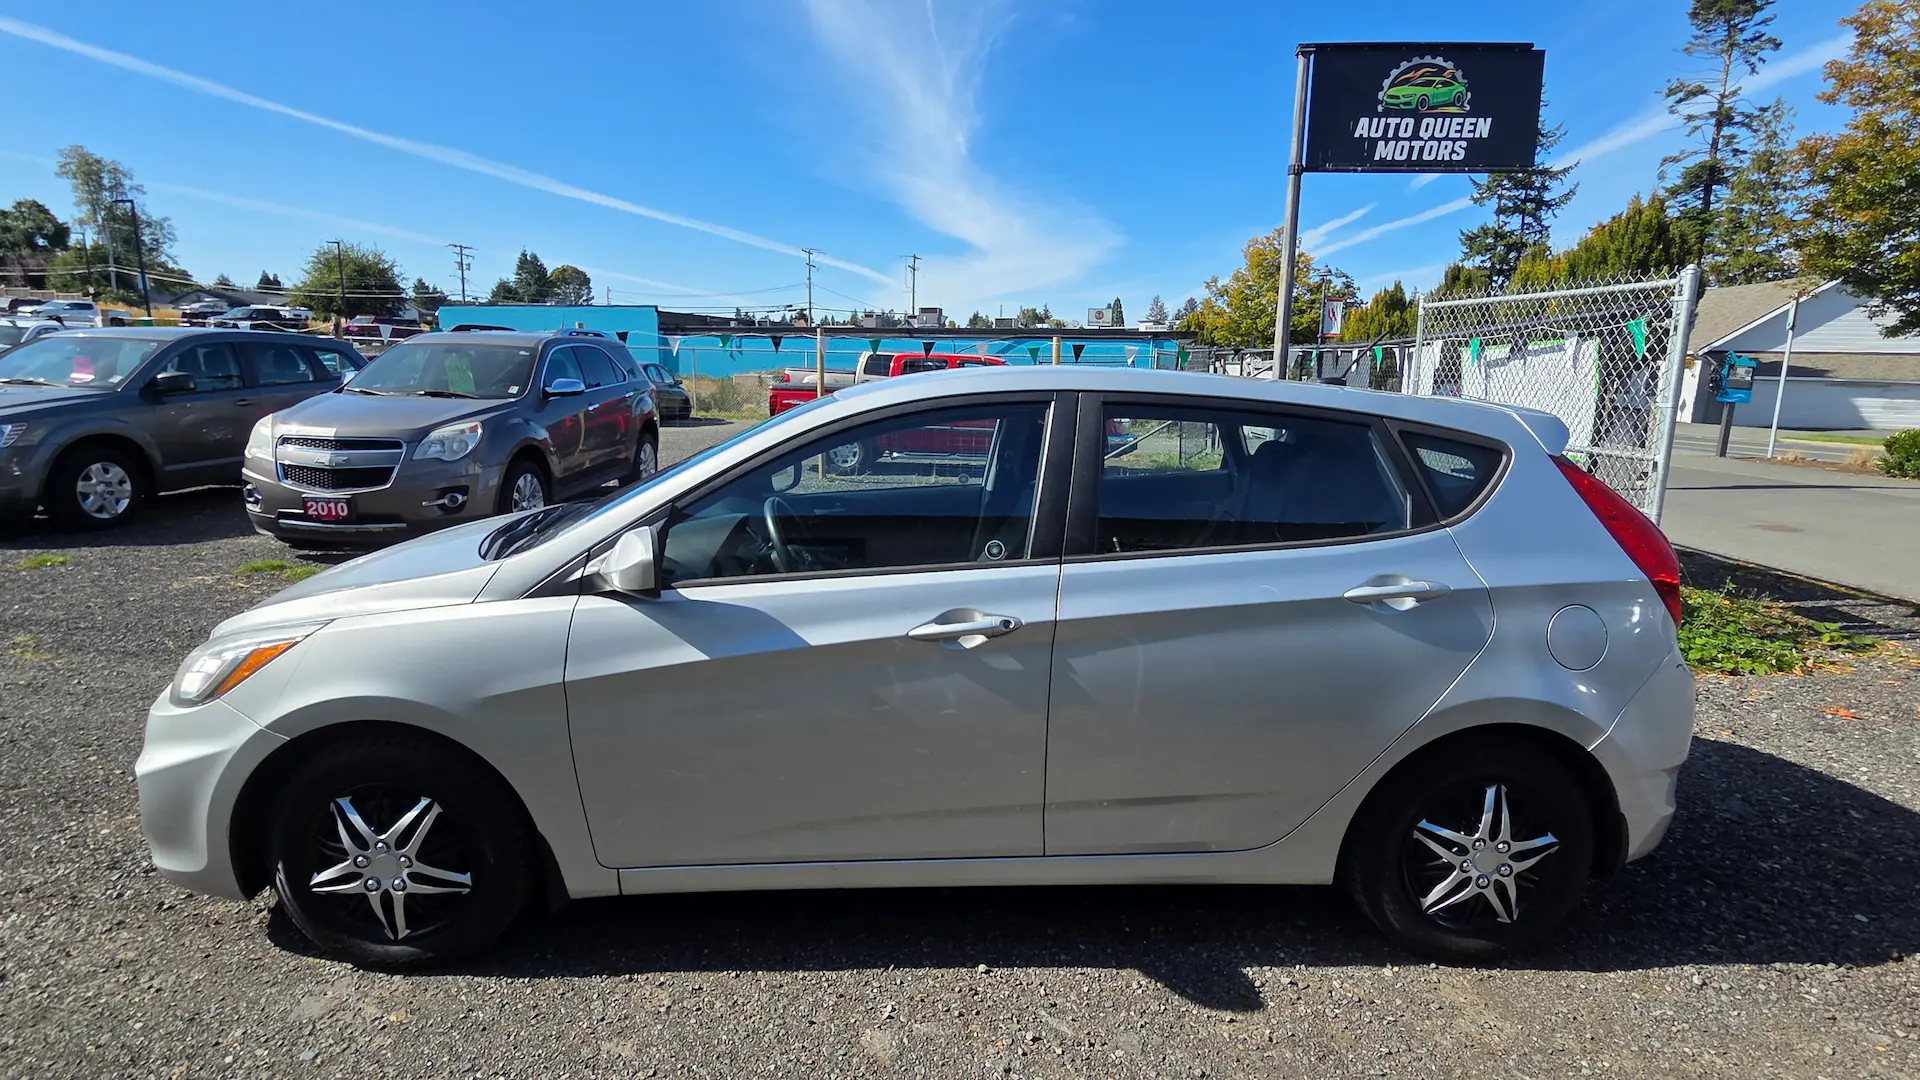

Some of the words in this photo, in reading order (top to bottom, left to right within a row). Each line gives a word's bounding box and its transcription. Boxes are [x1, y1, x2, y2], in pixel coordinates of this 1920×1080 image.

[1354, 117, 1415, 138] AUTO
[1418, 117, 1492, 140] QUEEN
[1374, 140, 1467, 161] MOTORS
[307, 501, 348, 516] 2010
